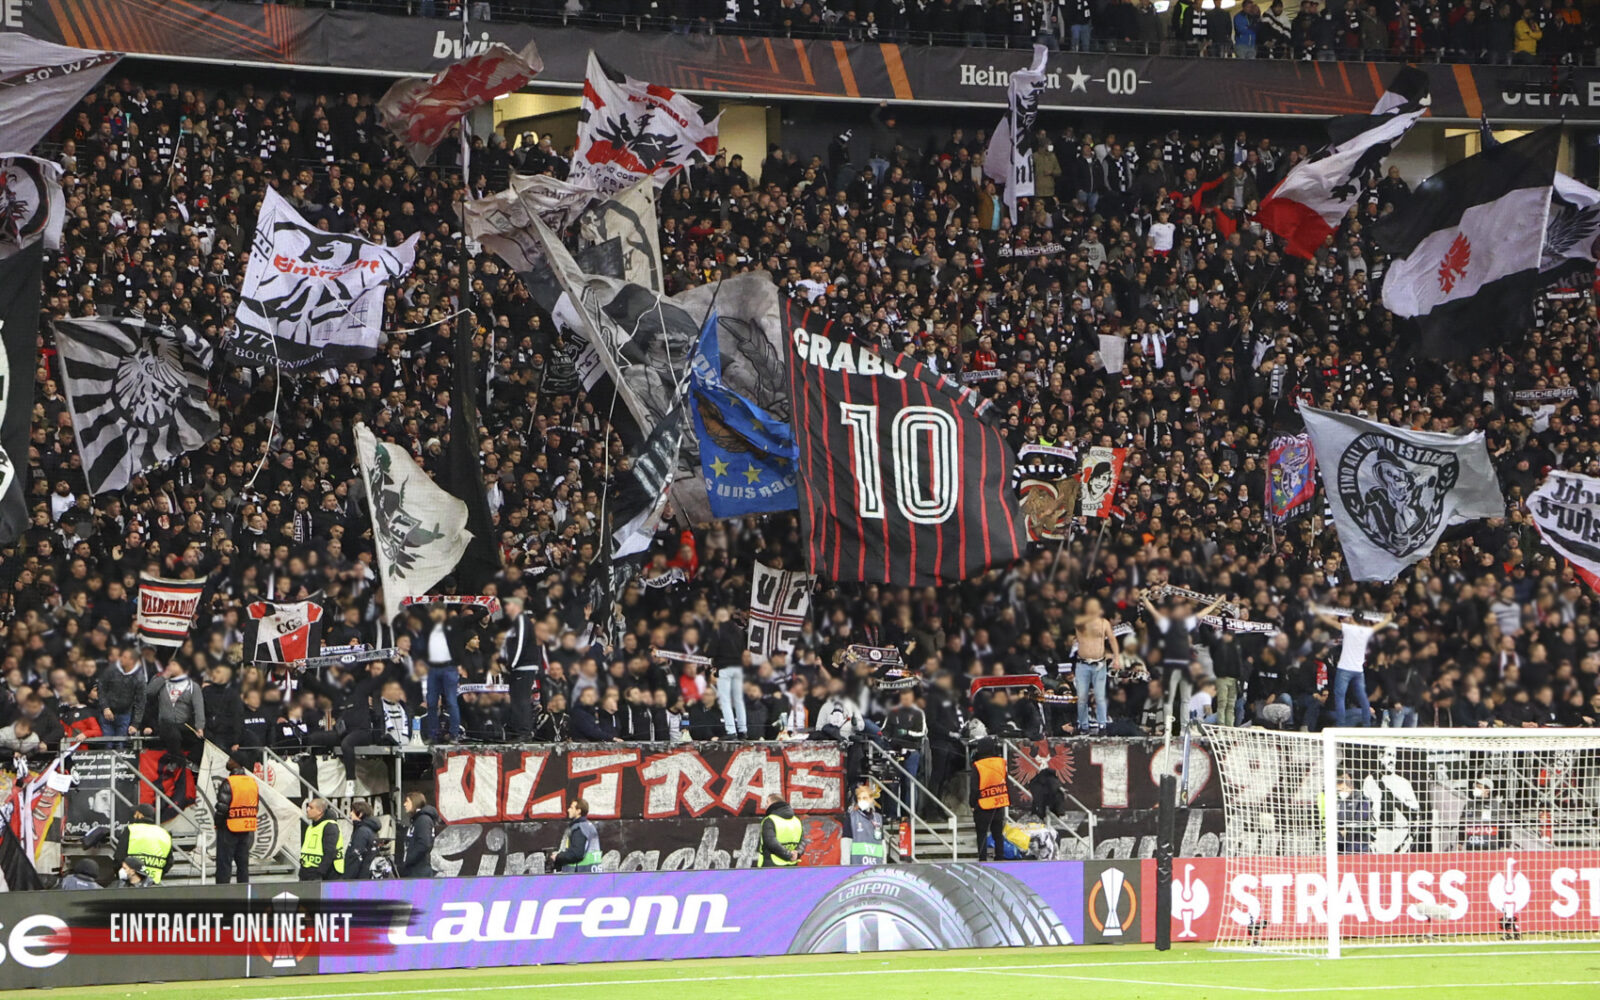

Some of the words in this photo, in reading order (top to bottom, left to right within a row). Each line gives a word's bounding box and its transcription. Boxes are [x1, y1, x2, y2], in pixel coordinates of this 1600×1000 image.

[433, 31, 496, 59] bwi
[960, 65, 1060, 88] Heinn
[1107, 68, 1136, 95] 0.0
[274, 254, 380, 280] Eintrht
[840, 402, 958, 524] 10
[717, 484, 756, 499] uns
[1341, 466, 1357, 495] FINO
[434, 748, 845, 825] ULTRAS
[430, 823, 765, 877] Einracht
[1229, 869, 1469, 926] STRAUSS
